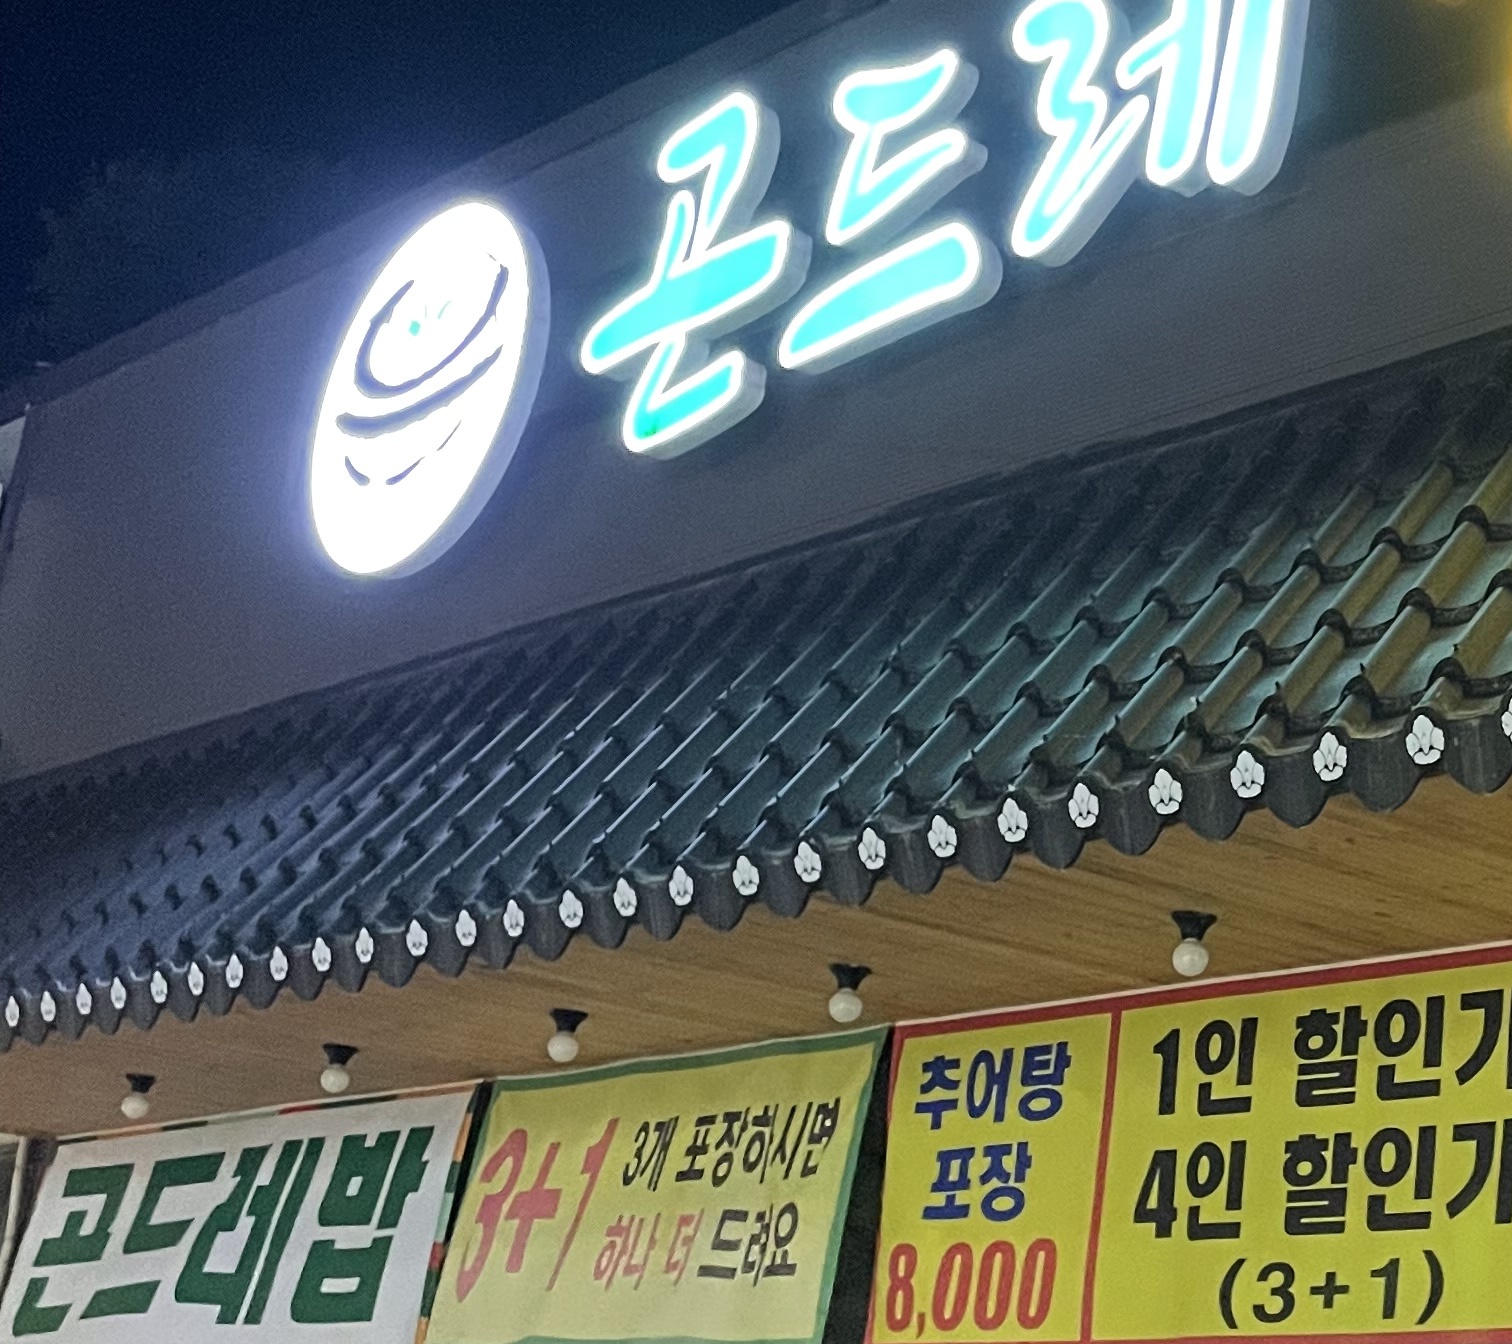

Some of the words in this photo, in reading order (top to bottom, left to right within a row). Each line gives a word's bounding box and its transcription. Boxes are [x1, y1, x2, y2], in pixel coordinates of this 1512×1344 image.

[912, 1040, 1073, 1133] 추어탕
[1151, 1016, 1255, 1118] 1인
[622, 1115, 673, 1192] 3개
[675, 1096, 842, 1188] 포장하시면
[920, 1144, 1033, 1223] 포장
[1133, 1141, 1246, 1241] 4인
[12, 1124, 436, 1338] 곤드레밥
[455, 1116, 621, 1304] 3+1
[592, 1214, 661, 1293] 하나
[664, 1207, 704, 1286] 더
[696, 1200, 803, 1283] 드려요
[884, 1238, 1059, 1340] 8,000
[1218, 1249, 1447, 1332] (3+1)
